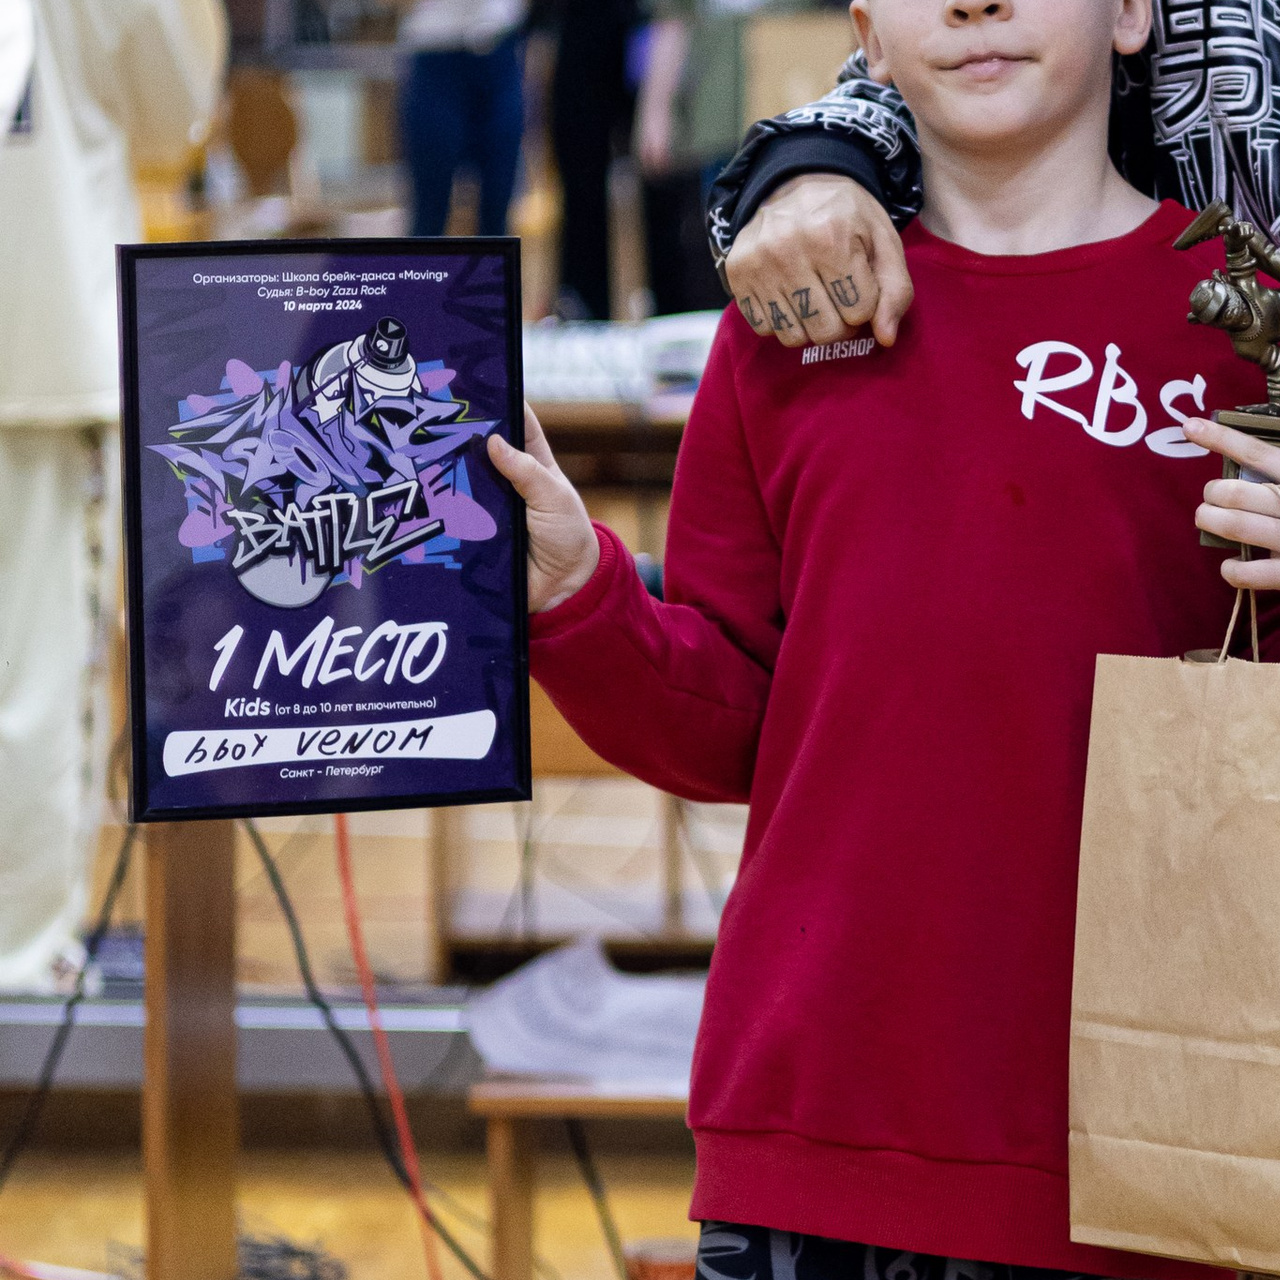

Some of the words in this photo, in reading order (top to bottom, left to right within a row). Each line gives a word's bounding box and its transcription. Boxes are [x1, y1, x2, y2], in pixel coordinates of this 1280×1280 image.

[192, 273, 280, 286] Организаторы:
[282, 272, 320, 283] Школа
[322, 271, 396, 283] брейк-данса
[398, 269, 449, 281] «Moving»
[257, 287, 294, 298] Судья:
[296, 286, 330, 298] B-boy
[332, 286, 358, 297] Zazu
[360, 285, 387, 296] Rock
[740, 275, 861, 331] ZAZU
[283, 301, 296, 312] 10
[298, 301, 334, 313] марта
[335, 300, 363, 311] 2024
[801, 337, 875, 365] HATERSHOP
[1013, 340, 1211, 458] RBS
[227, 479, 443, 569] BATTLE
[208, 624, 244, 692] 1
[252, 615, 449, 690] МЕСТО
[224, 698, 271, 717] Kids
[274, 702, 291, 716] (от
[293, 703, 301, 714] 8
[302, 704, 318, 715] до
[320, 702, 332, 713] 10
[334, 703, 354, 713] лет
[355, 697, 437, 712] включительно)
[279, 767, 314, 779] Санкт
[325, 764, 384, 779] Петербург
